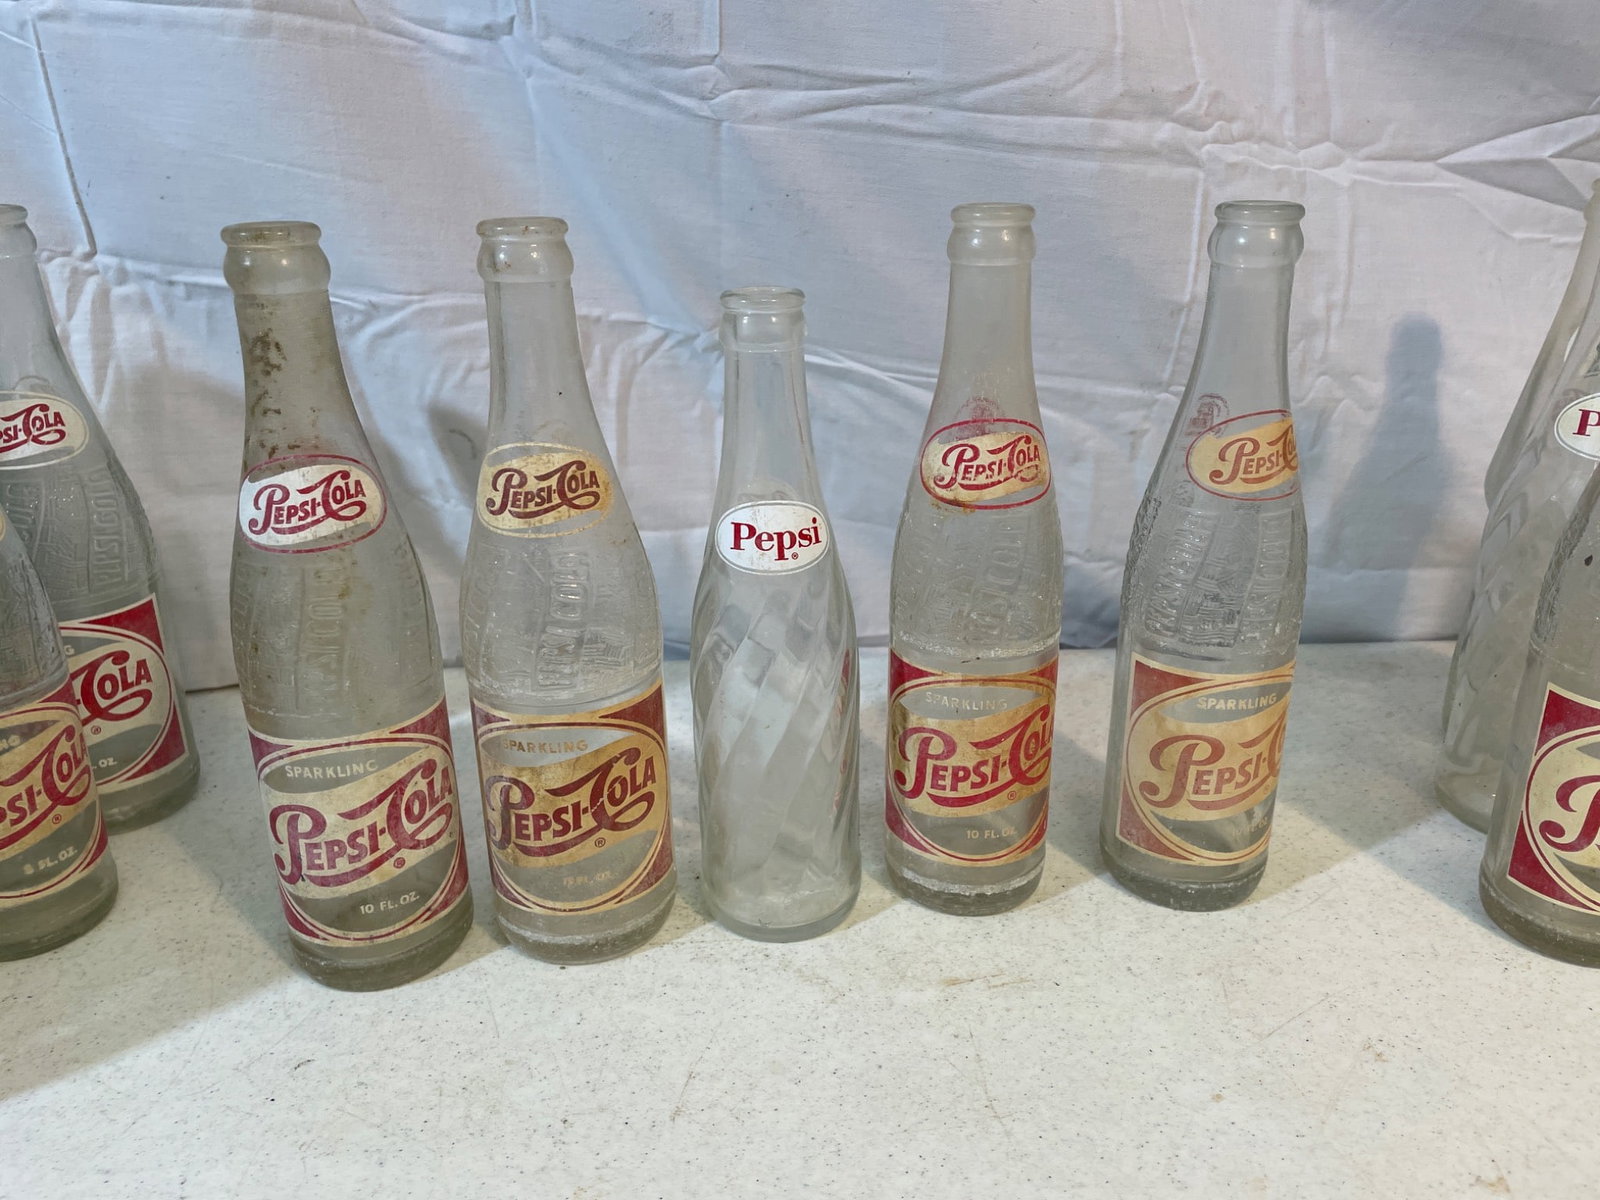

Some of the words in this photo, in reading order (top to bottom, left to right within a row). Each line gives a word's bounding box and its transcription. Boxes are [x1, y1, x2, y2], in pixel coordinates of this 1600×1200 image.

[249, 470, 367, 535] PEPSI-COLA
[486, 460, 600, 519] PEPSI-COLA
[730, 516, 819, 560] Pepsi
[1196, 692, 1277, 711] SPARKLING
[269, 758, 453, 887] PEPSI-COLA
[486, 747, 656, 857] PEPSI-COLA
[966, 829, 979, 839] 10
[360, 904, 374, 915] 10
